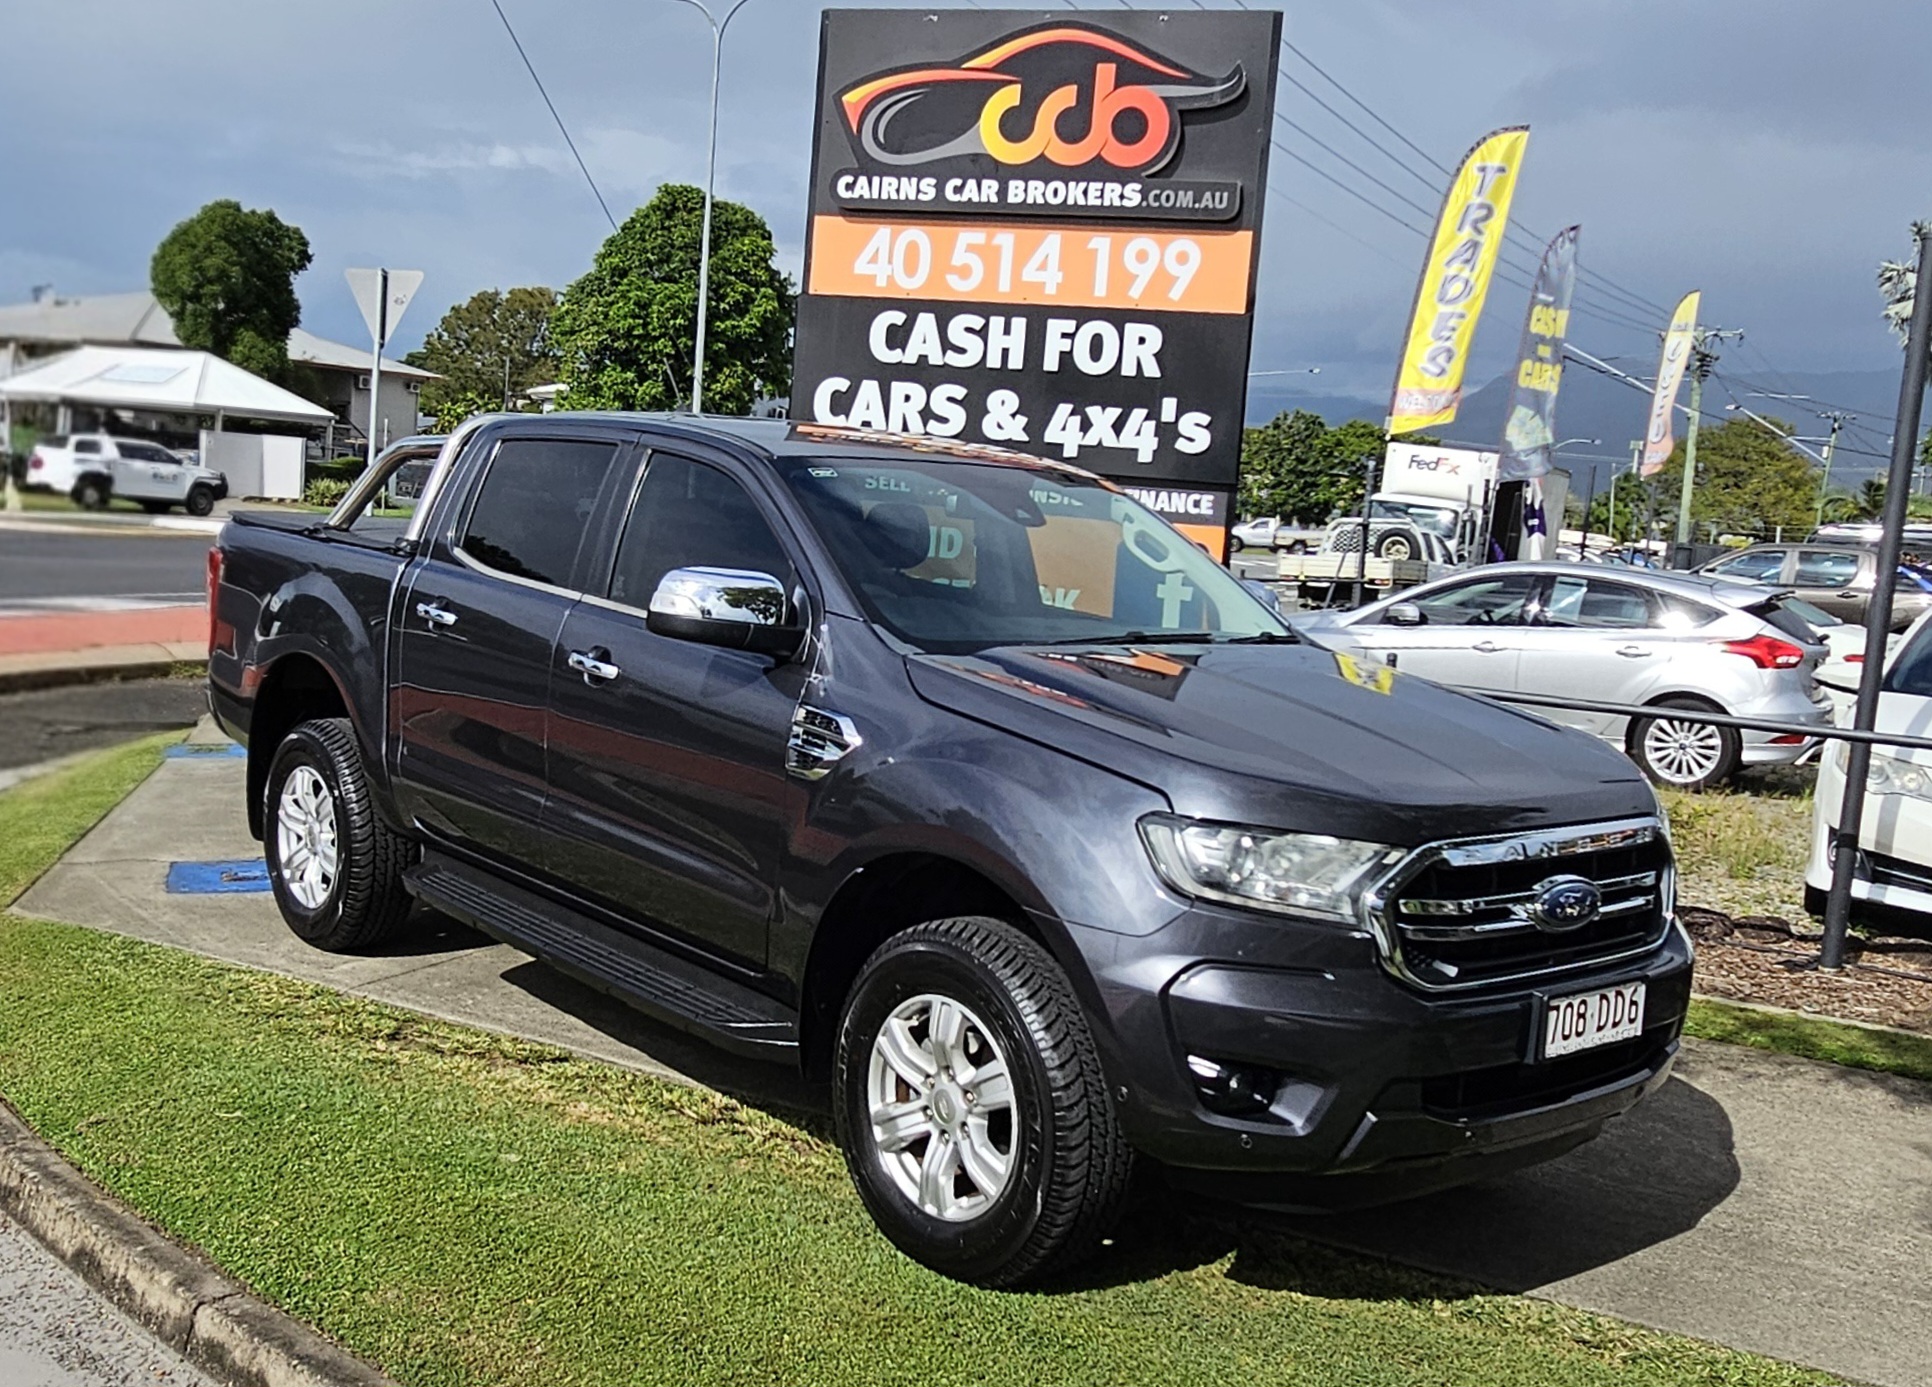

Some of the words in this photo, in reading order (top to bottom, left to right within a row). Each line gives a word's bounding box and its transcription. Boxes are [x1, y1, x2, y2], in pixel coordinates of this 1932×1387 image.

[836, 174, 936, 203] CAIRNS
[944, 177, 999, 205] CAR
[853, 226, 932, 290] 40
[945, 230, 1063, 295] 514
[1087, 236, 1202, 301] 199
[1420, 164, 1507, 378] TRADES
[869, 310, 1027, 371] CASH
[1043, 317, 1164, 379] FOR
[812, 377, 968, 437] CARS
[981, 389, 1029, 443] &
[1407, 454, 1461, 476] FedEx
